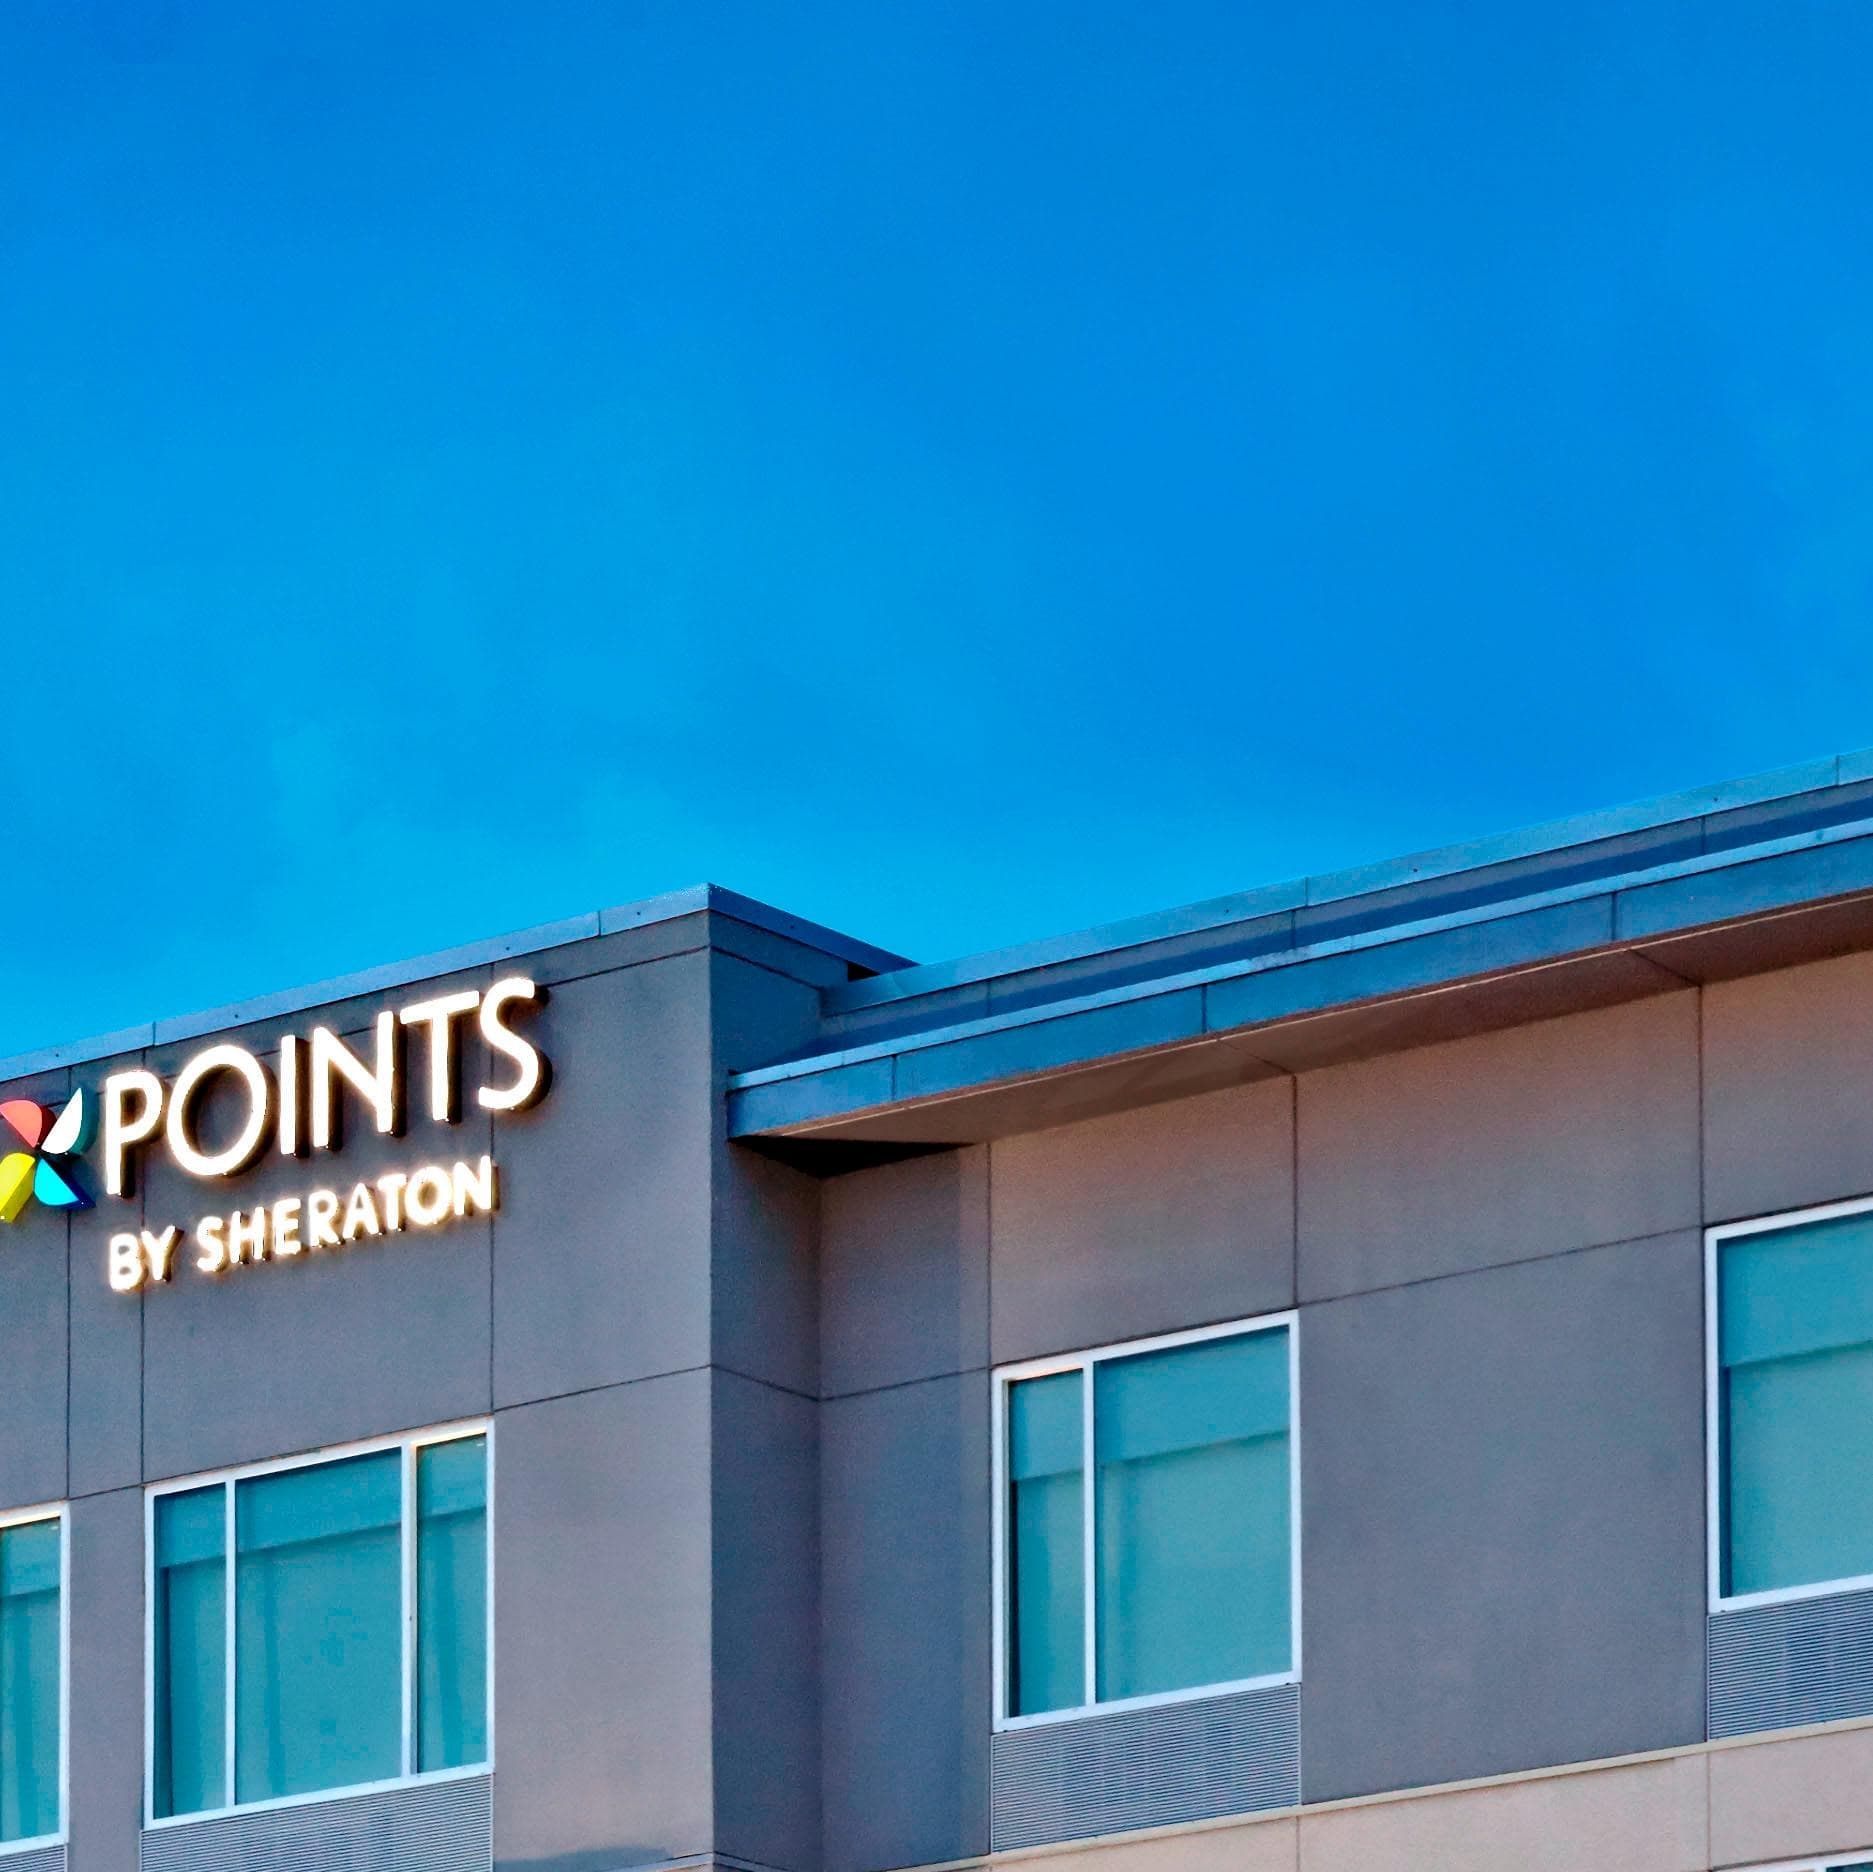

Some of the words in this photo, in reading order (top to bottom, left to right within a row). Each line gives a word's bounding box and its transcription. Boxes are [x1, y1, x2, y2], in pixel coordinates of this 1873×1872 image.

[104, 976, 544, 1198] POINTS
[107, 1225, 178, 1293] BY
[195, 1155, 495, 1274] SHERATON
